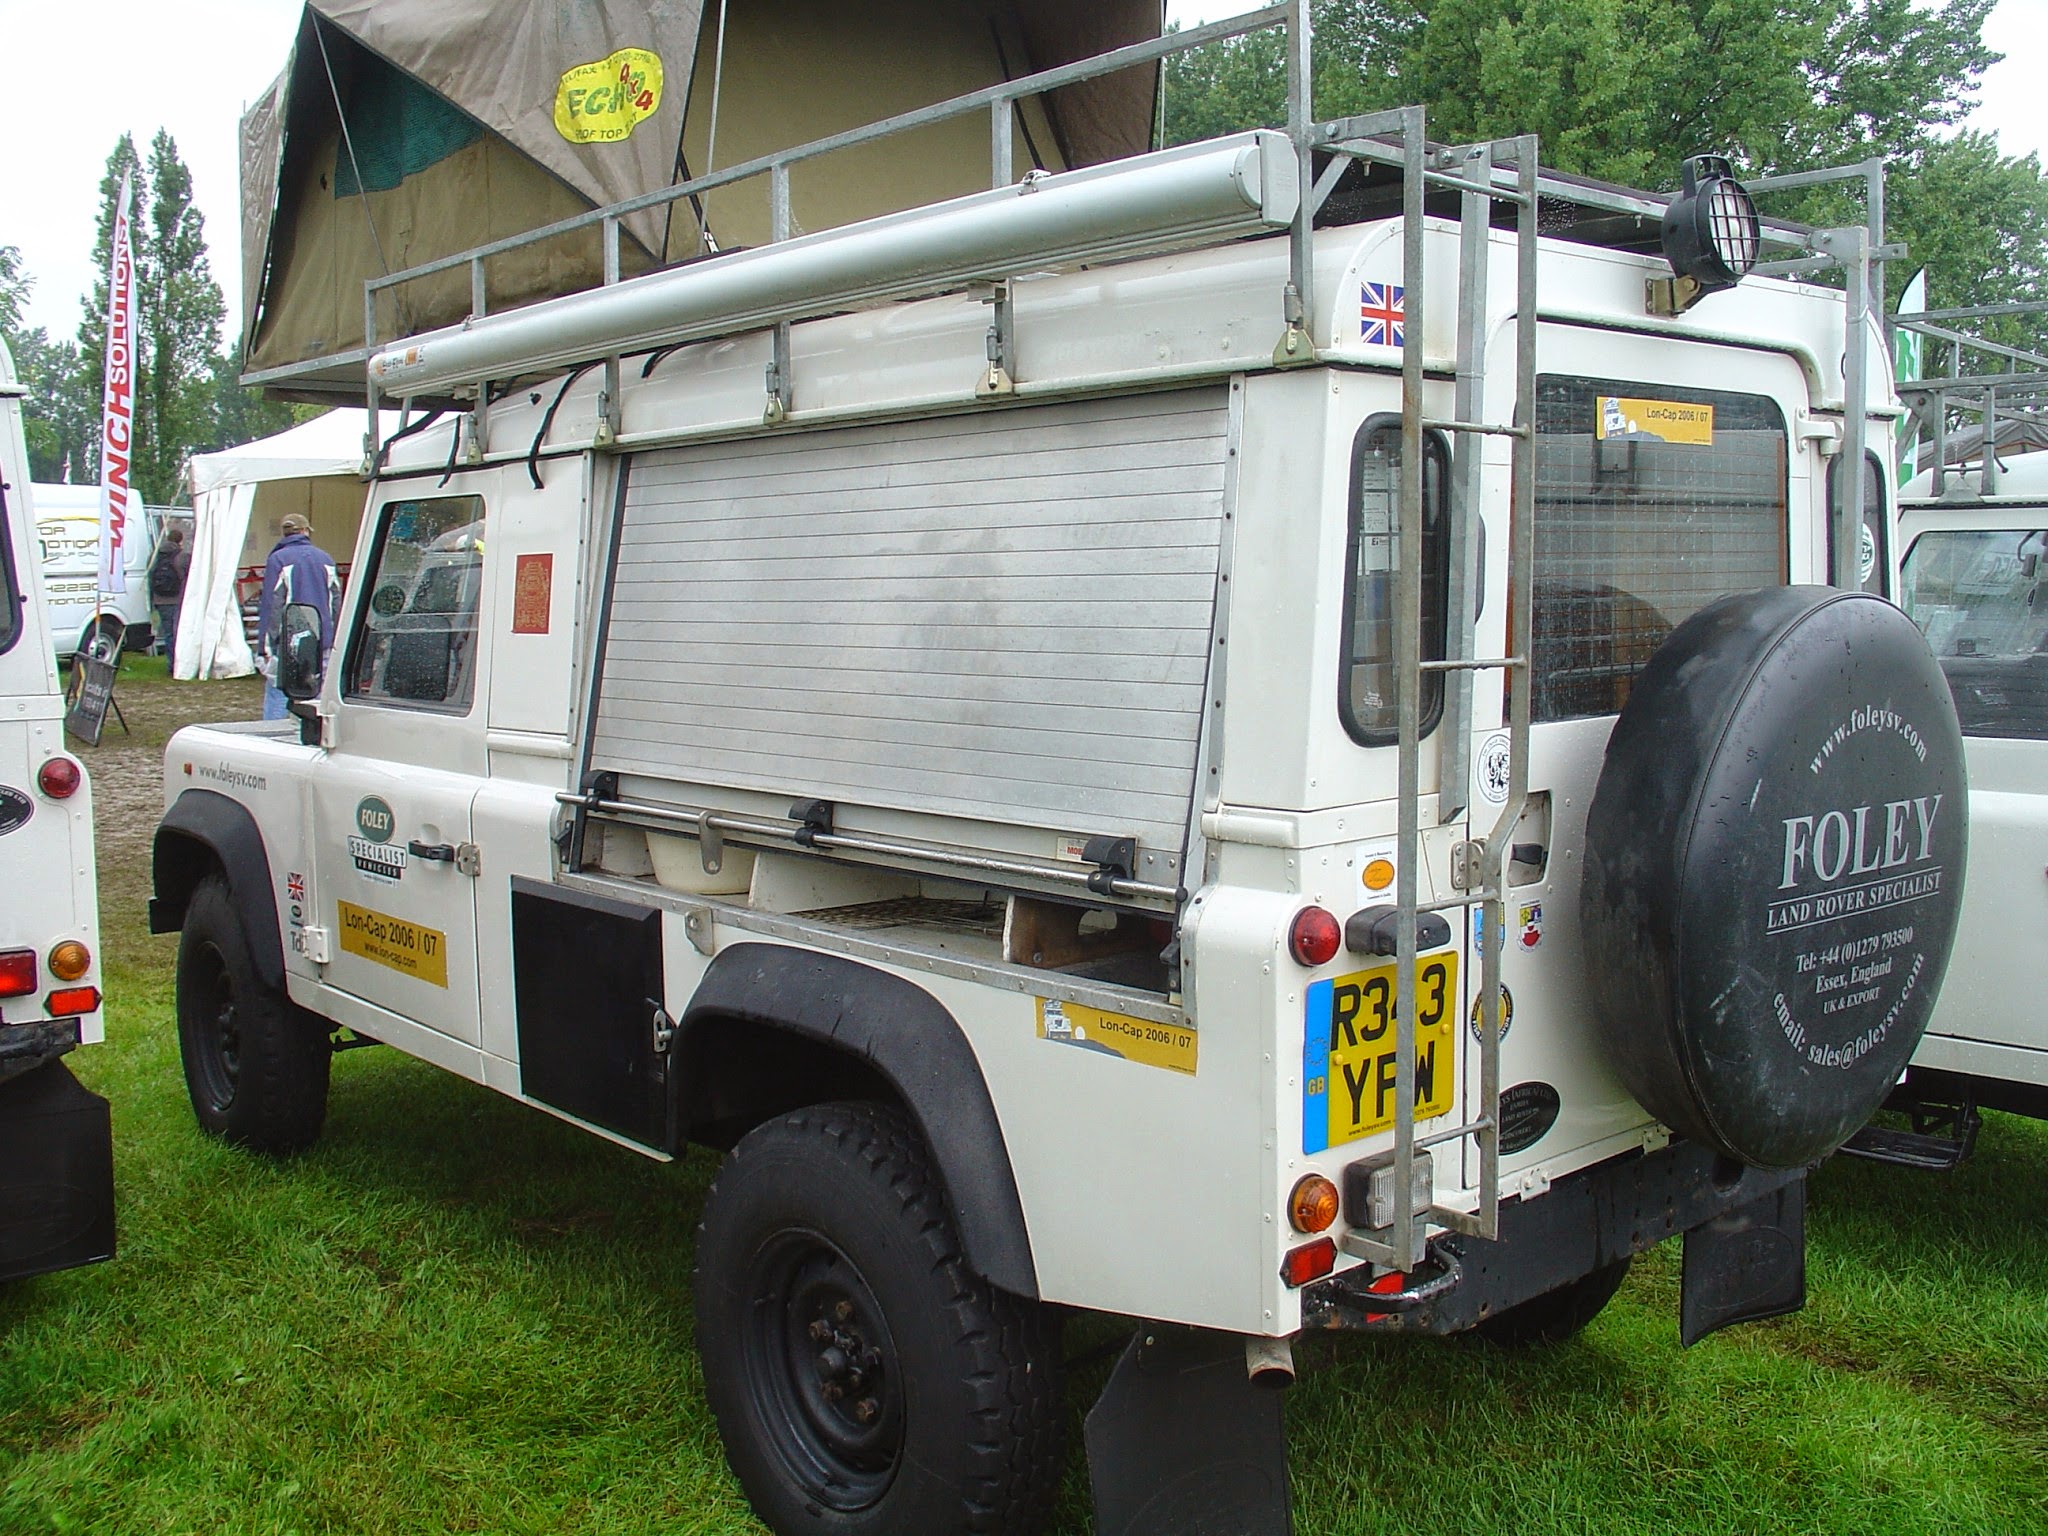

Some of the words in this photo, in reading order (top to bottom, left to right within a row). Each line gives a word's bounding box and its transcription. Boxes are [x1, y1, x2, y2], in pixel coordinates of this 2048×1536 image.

[600, 128, 622, 139] TOP
[109, 226, 128, 386] SOLUTIONS
[1646, 407, 1677, 422] Lon-Cap
[1678, 409, 1695, 421] 2006
[1700, 412, 1708, 423] 07
[106, 386, 130, 570] WINCH
[1810, 704, 1928, 775] www.foleysv.com
[199, 761, 267, 791] www.foleysv.com
[361, 808, 390, 830] FOLEY
[349, 841, 405, 866] SPECIALIST
[1777, 793, 1943, 890] FOLEY
[357, 860, 397, 877] VEHICLES
[1767, 903, 1811, 929] LAND
[1816, 890, 1865, 918] ROVER
[1869, 872, 1942, 906] SPECIALIST
[345, 907, 387, 943] Lon-Cap
[389, 922, 415, 949] 2006
[423, 933, 437, 957] 07
[1797, 952, 1817, 973] Tel:
[1820, 946, 1840, 965] +44
[1841, 935, 1880, 965] (0)1279
[1880, 926, 1914, 951] 793500
[1815, 973, 1848, 994] Essex,
[1850, 957, 1892, 985] England
[1331, 963, 1446, 1052] R33
[1773, 993, 1806, 1053] email:
[1808, 952, 1925, 1070] sales@foleysv.com
[1824, 1001, 1838, 1015] UK
[1838, 997, 1845, 1010] &
[1847, 987, 1881, 1008] EXPORT
[1099, 1016, 1143, 1039] Lon-Cap
[1146, 1028, 1170, 1044] 2006
[1178, 1035, 1191, 1048] 07
[1308, 1076, 1325, 1096] GB
